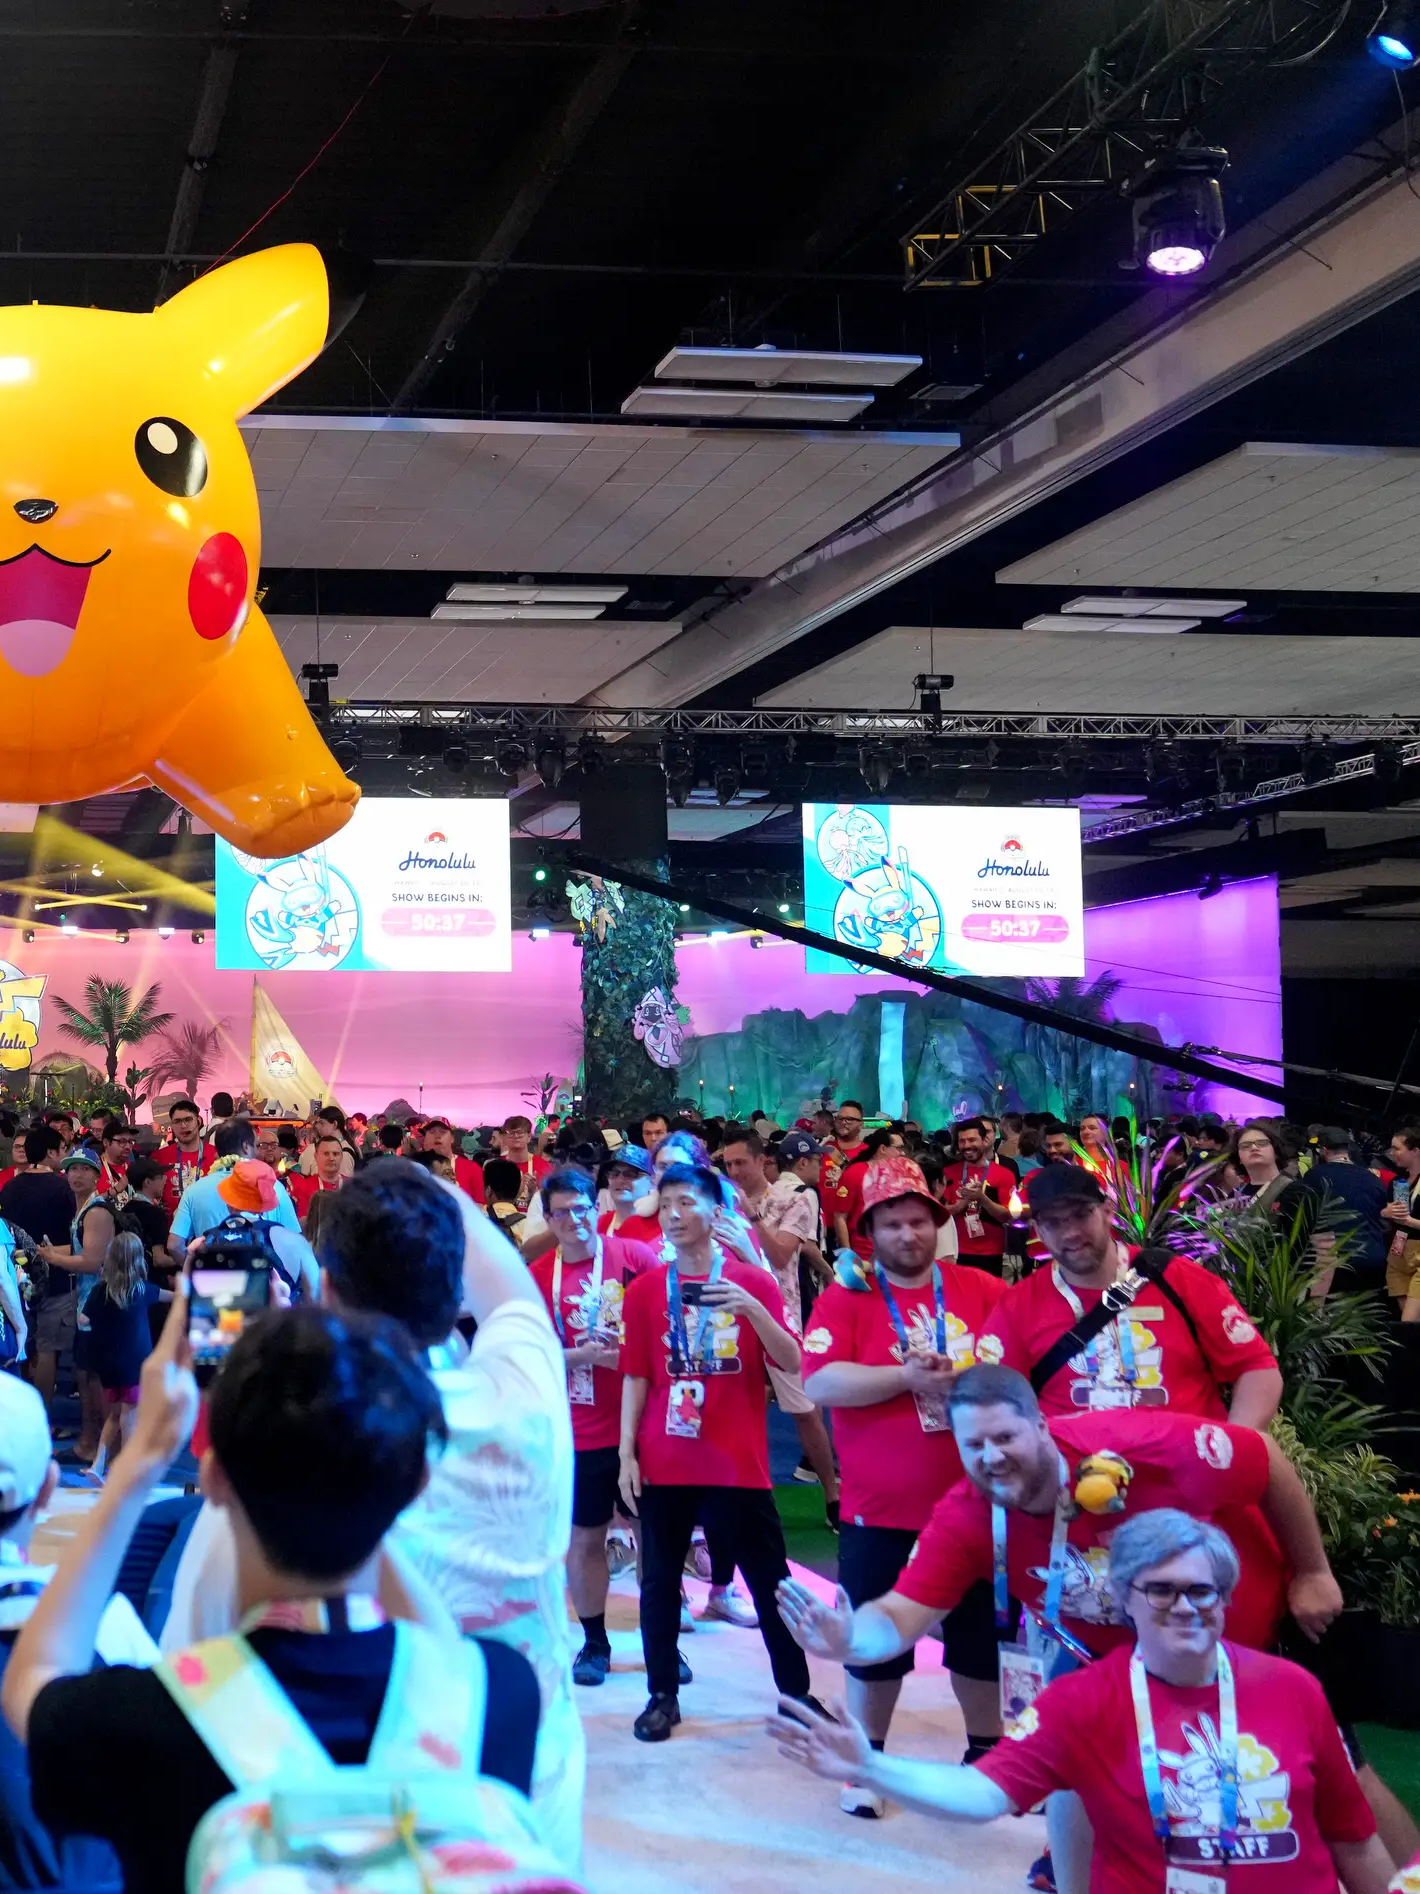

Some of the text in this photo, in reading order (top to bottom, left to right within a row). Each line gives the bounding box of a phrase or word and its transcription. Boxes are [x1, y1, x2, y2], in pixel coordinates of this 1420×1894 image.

[398, 850, 476, 871] Honolulu
[977, 858, 1050, 878] Honolulu
[391, 893, 483, 903] SHOW BEGINS IN:
[971, 899, 1057, 909] SHOW BEGINS IN:
[411, 913, 466, 931] 50:37
[990, 919, 1041, 937] 50:37
